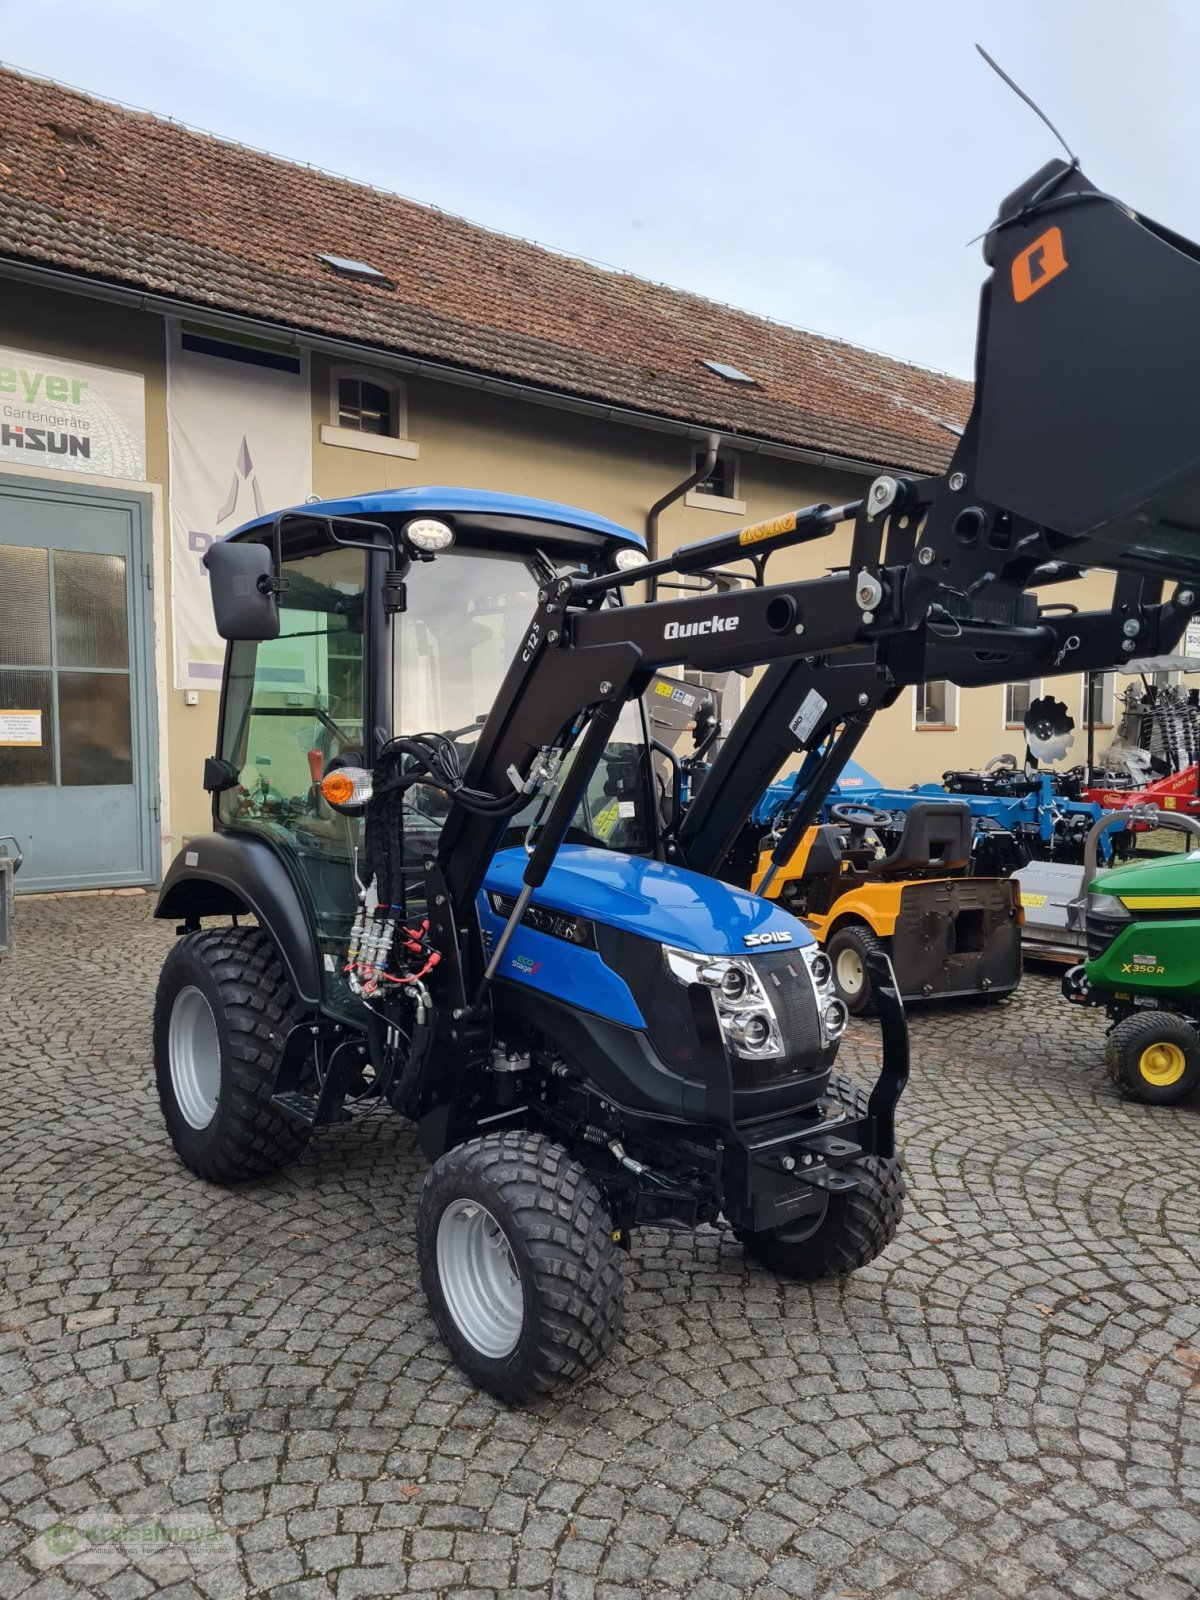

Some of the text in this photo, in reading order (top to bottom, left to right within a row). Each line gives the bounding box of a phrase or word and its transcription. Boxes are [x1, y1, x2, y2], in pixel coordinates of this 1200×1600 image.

[3, 405, 90, 430] Gartengeräte
[1, 423, 90, 458] HSUN
[664, 615, 739, 640] Quicke
[743, 931, 792, 947] SOLIS
